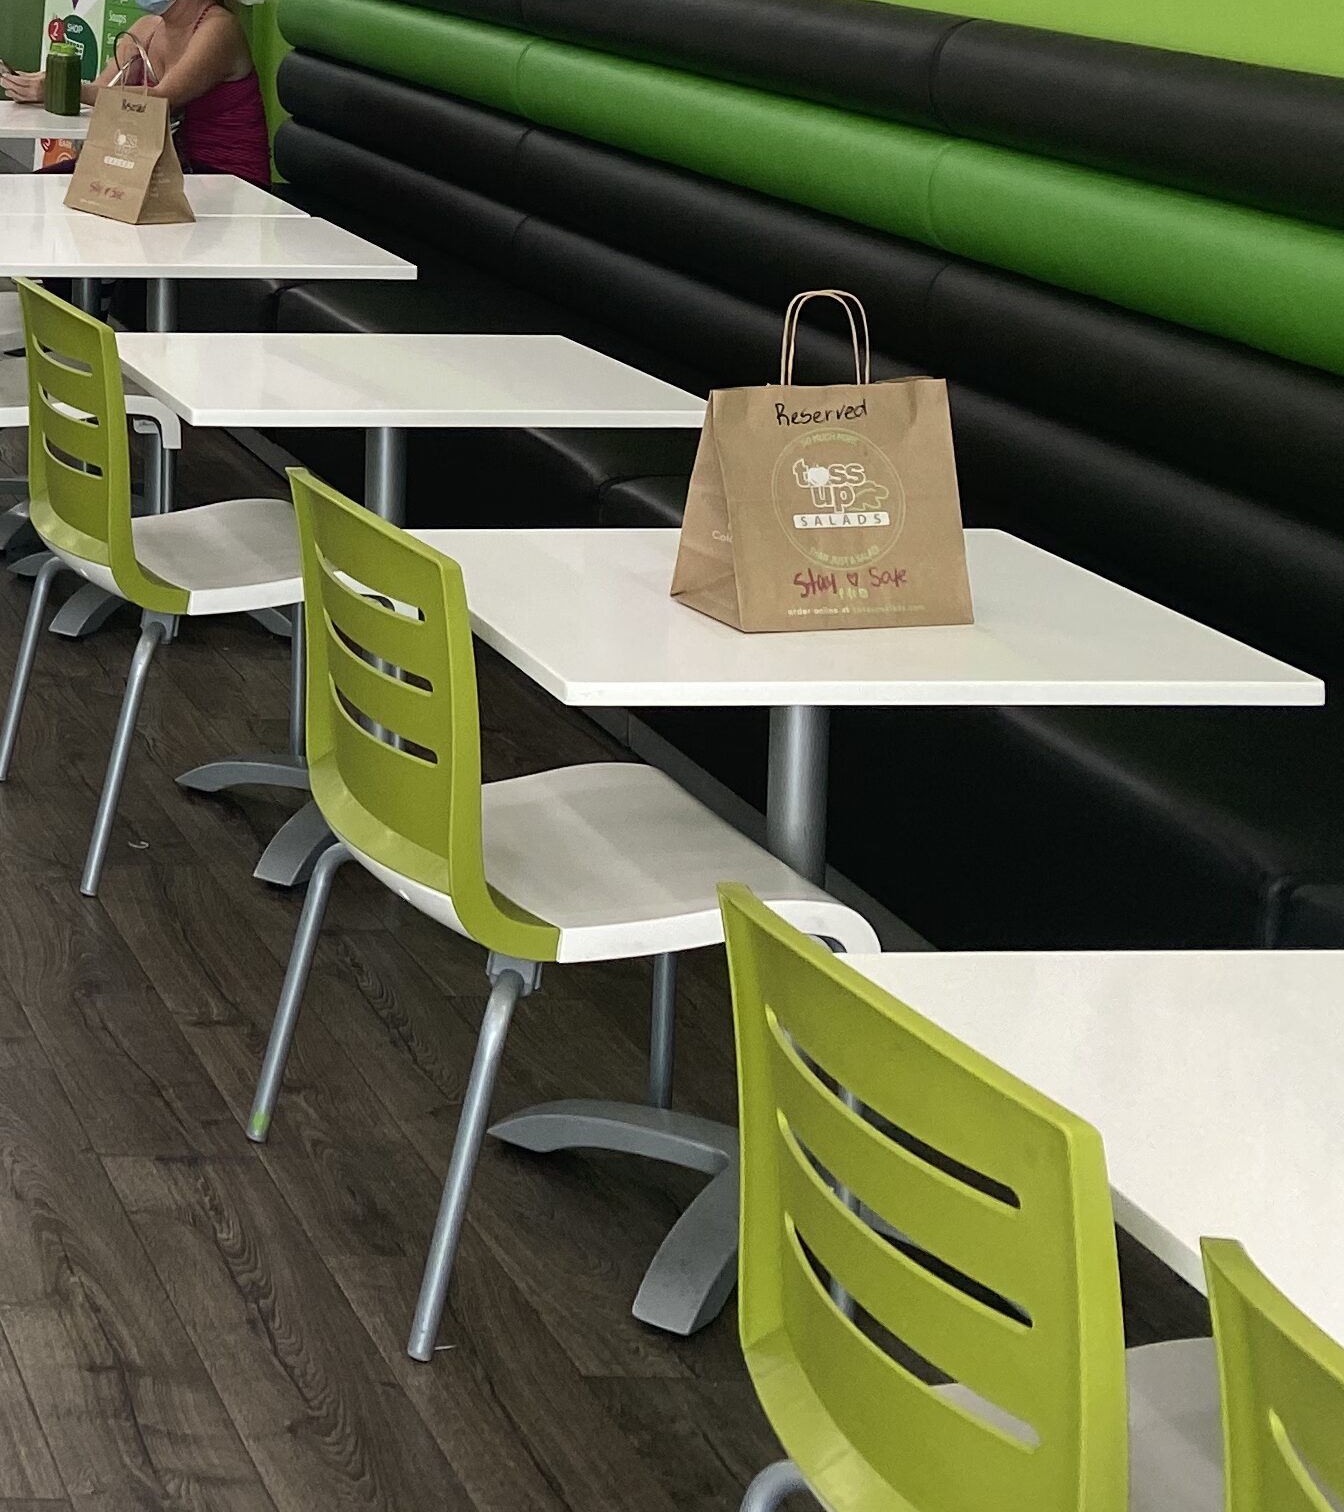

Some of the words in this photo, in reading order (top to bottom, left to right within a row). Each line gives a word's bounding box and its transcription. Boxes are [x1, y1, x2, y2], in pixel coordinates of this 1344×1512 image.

[53, 21, 59, 37] 2
[67, 22, 84, 34] SHOP
[775, 399, 868, 426] Reserved
[811, 484, 858, 514] up
[799, 514, 883, 527] SALADS
[793, 568, 838, 598] Stay
[787, 607, 811, 616] order
[813, 606, 839, 615] online
